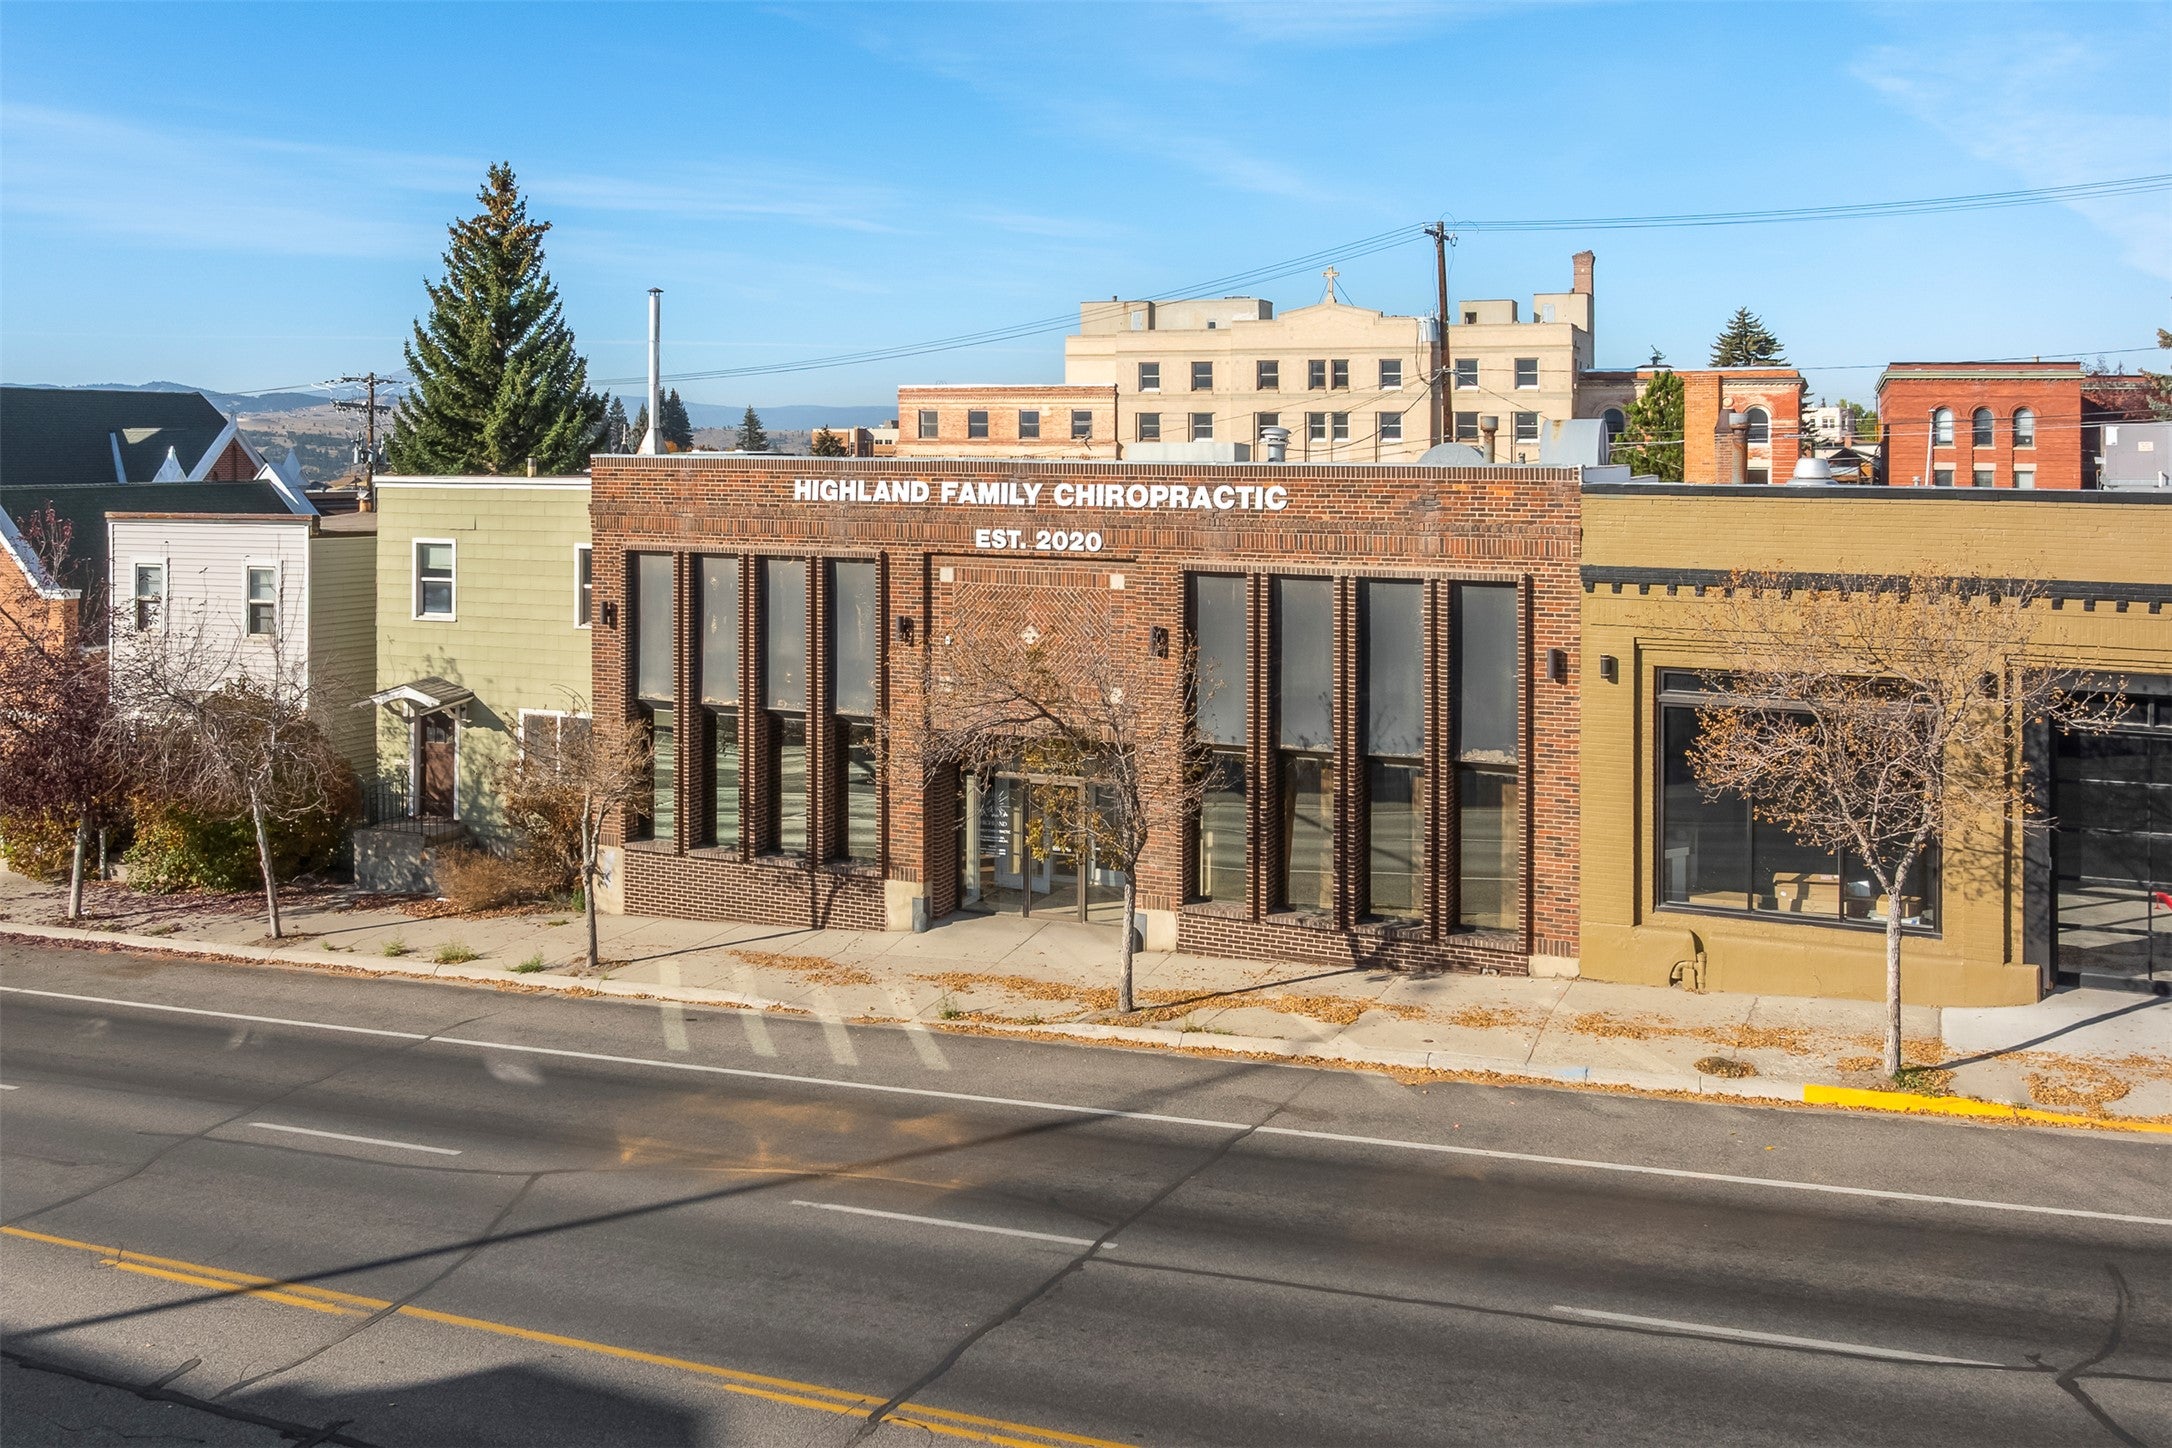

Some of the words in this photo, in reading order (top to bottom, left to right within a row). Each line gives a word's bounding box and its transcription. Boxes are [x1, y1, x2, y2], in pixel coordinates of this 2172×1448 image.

[793, 479, 930, 503] HIGHLAND
[940, 481, 1043, 506] FAMILY
[1053, 482, 1288, 511] CHIROPRACTIC
[975, 528, 1027, 550] EST.
[1035, 530, 1103, 552] 2020
